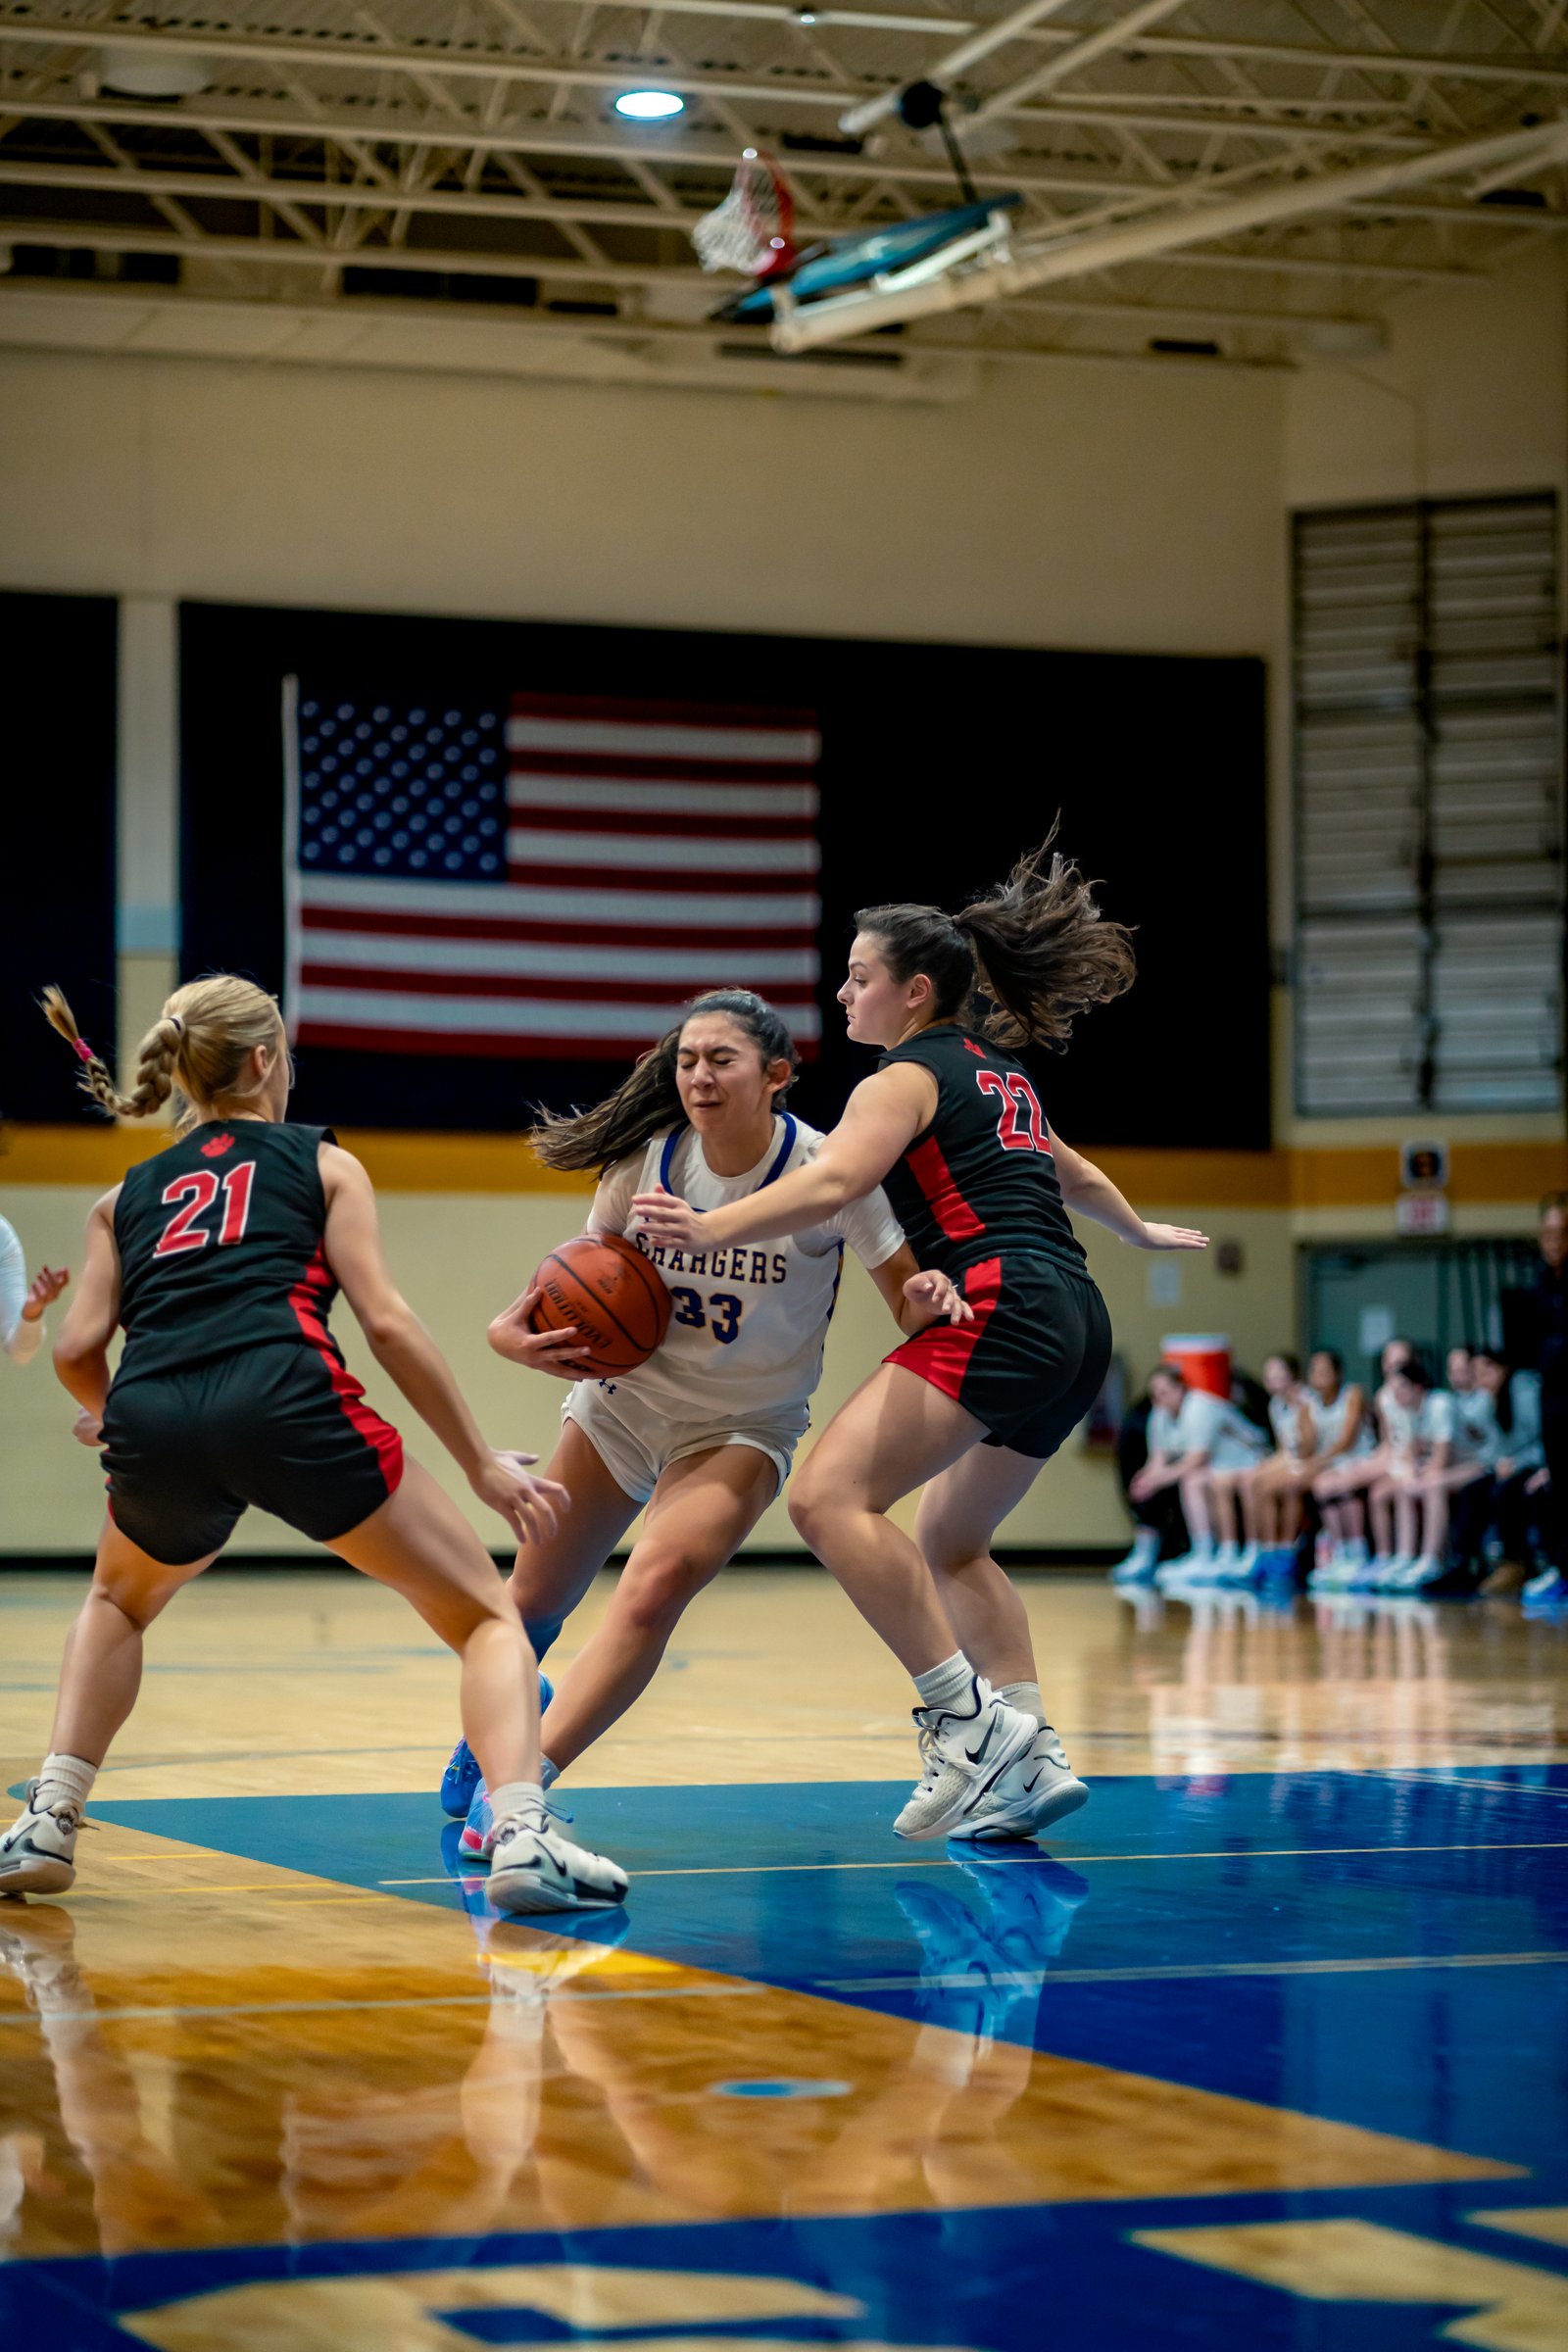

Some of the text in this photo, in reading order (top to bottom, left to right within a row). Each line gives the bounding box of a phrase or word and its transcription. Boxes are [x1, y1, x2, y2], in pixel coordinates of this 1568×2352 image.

[976, 1070, 1054, 1157] 22
[152, 1161, 256, 1258] 21
[669, 1286, 743, 1345] 33
